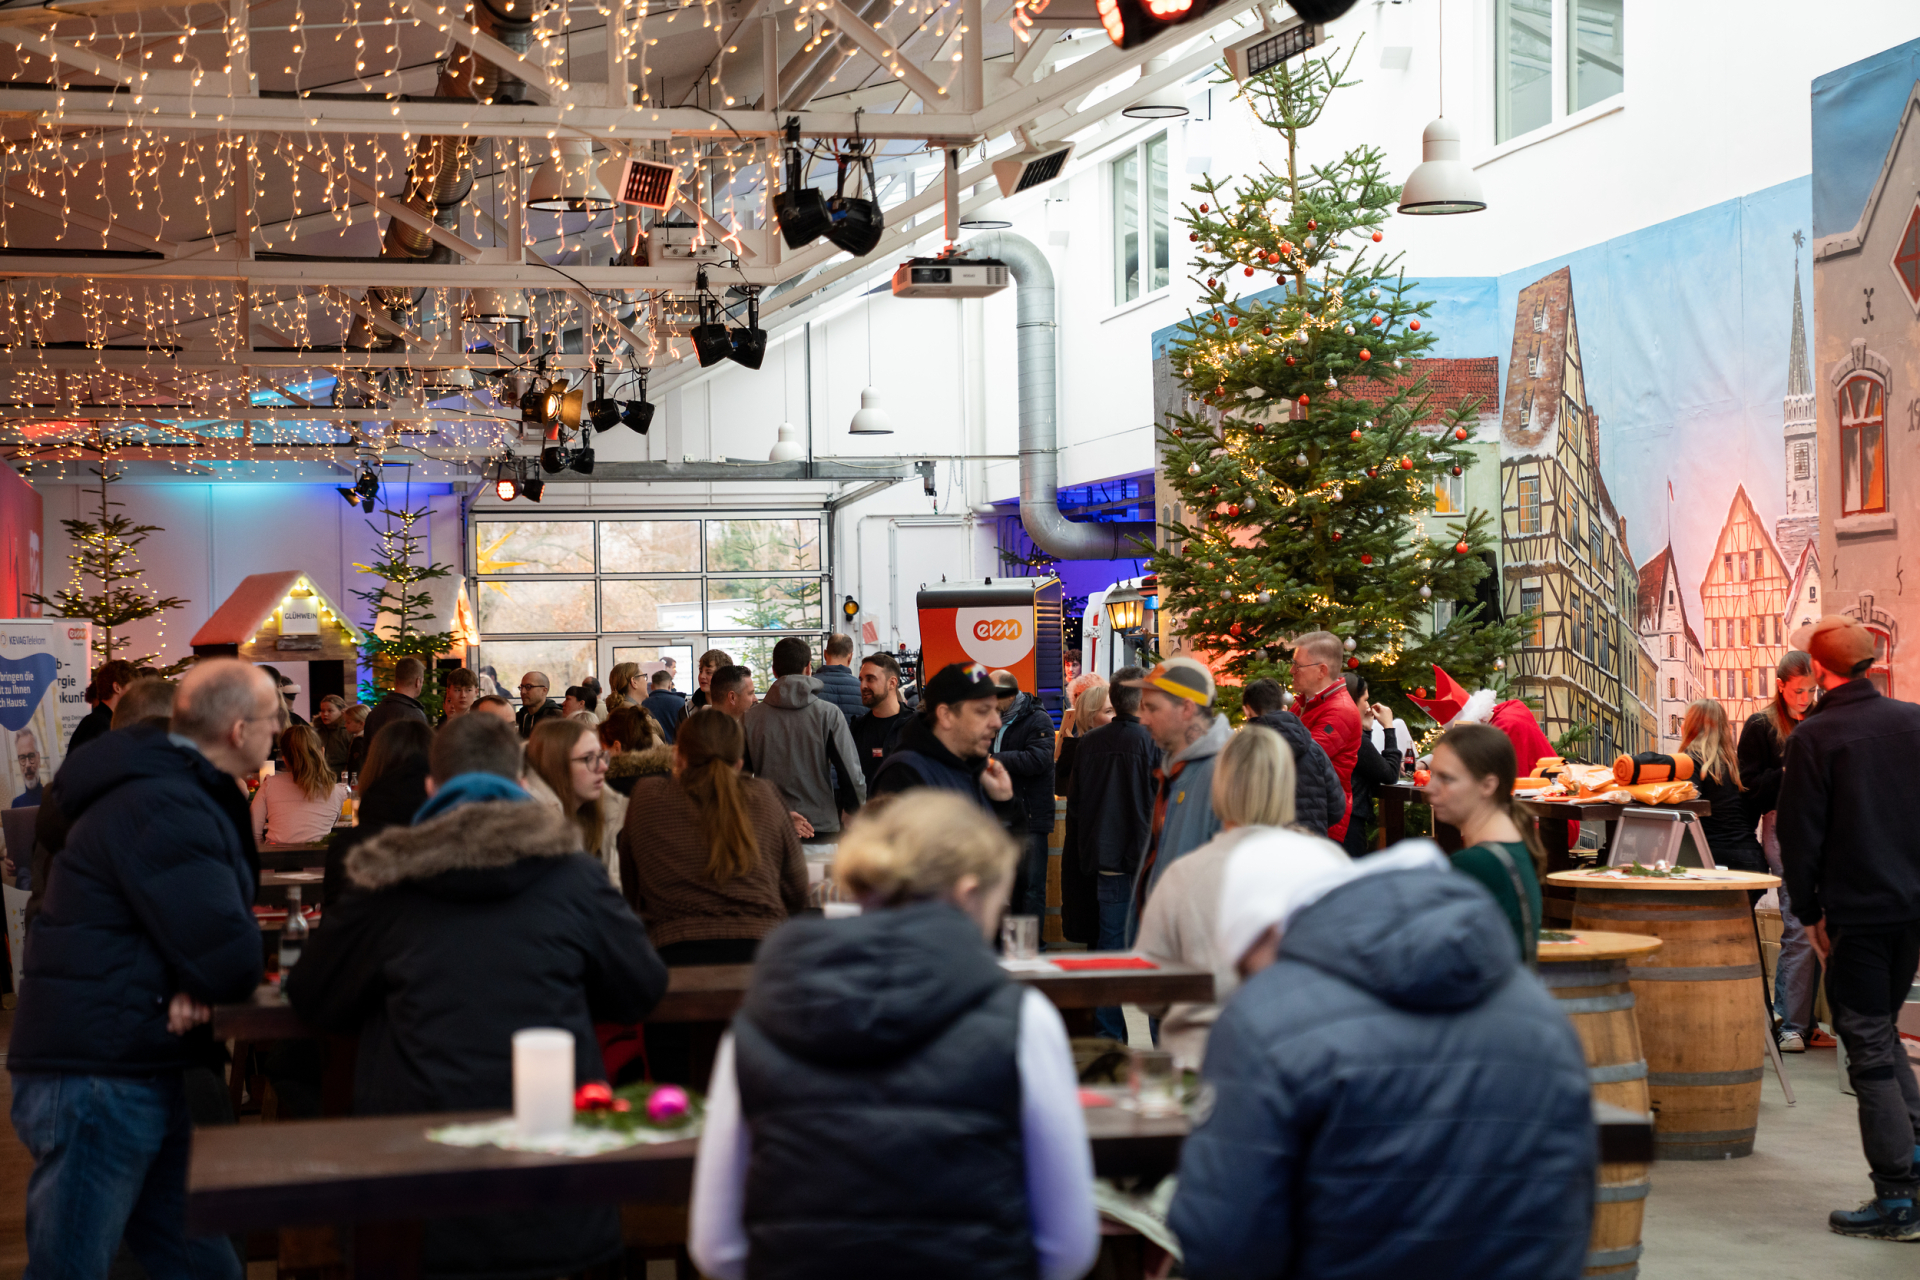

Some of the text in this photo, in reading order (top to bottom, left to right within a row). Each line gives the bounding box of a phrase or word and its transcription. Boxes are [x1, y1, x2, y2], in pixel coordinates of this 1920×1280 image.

[285, 611, 317, 619] GLÜHWEIN
[69, 629, 87, 639] evm
[976, 622, 1019, 639] evm
[24, 671, 34, 681] die
[5, 686, 12, 695] zu
[12, 685, 31, 695] Ihnen
[6, 698, 28, 708] Hause.
